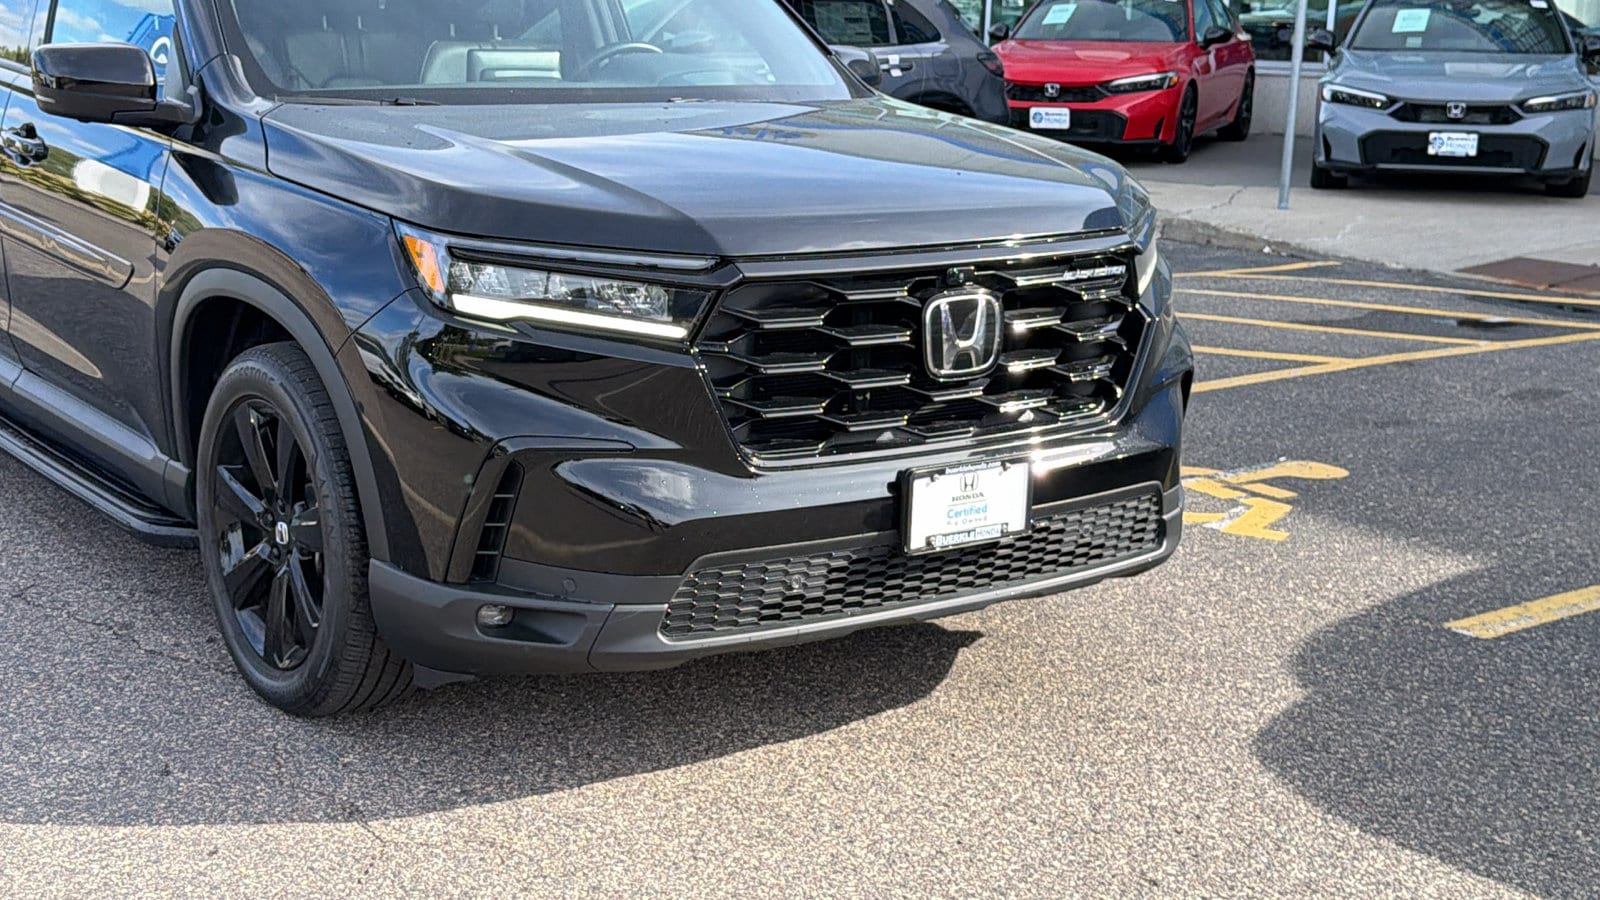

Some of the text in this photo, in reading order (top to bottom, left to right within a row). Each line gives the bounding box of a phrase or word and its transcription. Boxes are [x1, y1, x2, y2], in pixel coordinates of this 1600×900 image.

[951, 491, 985, 502] HONDA
[946, 504, 988, 519] Certified
[976, 526, 1001, 538] HONDA
